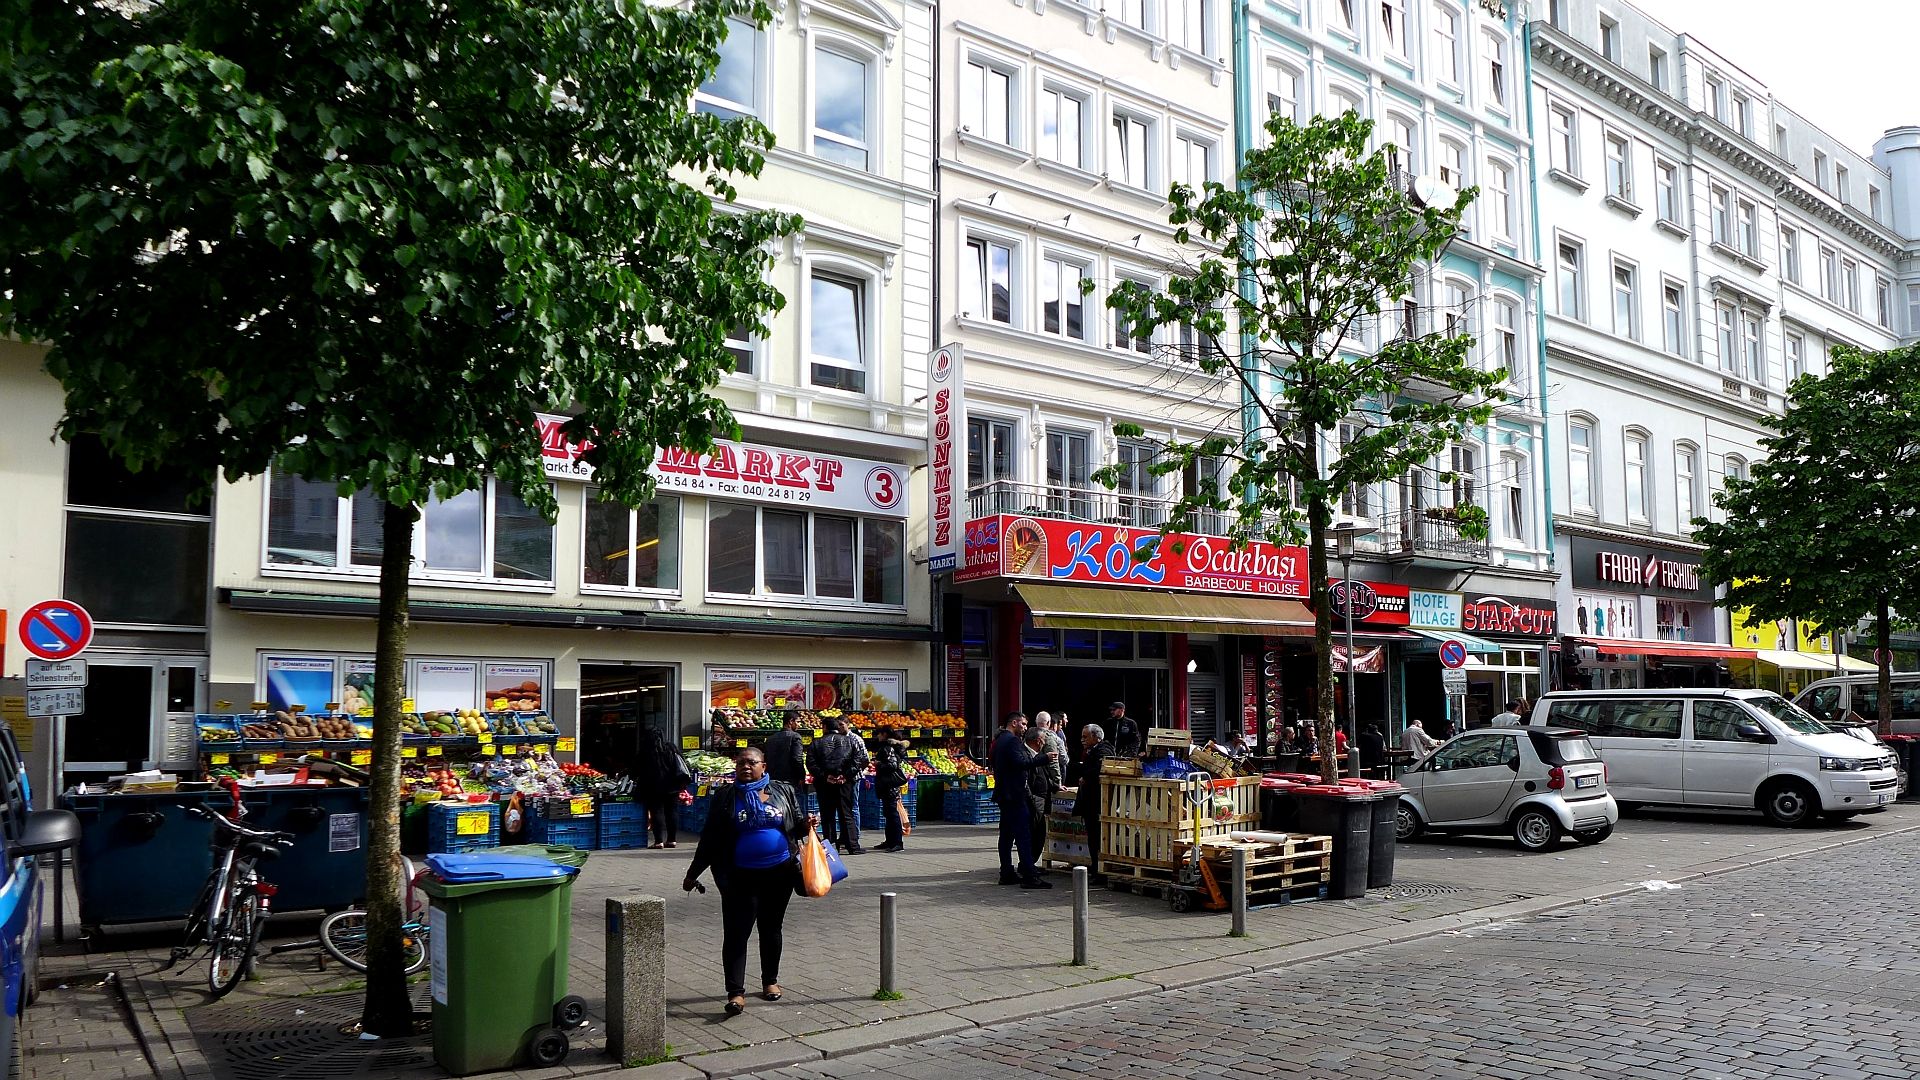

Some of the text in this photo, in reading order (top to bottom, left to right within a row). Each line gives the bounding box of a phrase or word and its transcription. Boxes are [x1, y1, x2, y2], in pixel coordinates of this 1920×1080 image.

[656, 442, 844, 492] MARKT
[933, 388, 951, 547] SÖNMEZ
[657, 474, 811, 502] 24 54 84 Fax: 040/ 24 81 29
[874, 472, 894, 504] 3
[929, 556, 955, 571] MARKT
[965, 549, 998, 567] cakbaşı
[1052, 528, 1165, 583] KÖZ
[1600, 551, 1642, 585] FABA
[1185, 575, 1300, 595] BARBECUE HOUSE
[1661, 560, 1700, 591] FASHION
[1413, 593, 1449, 609] HOTEL
[1464, 602, 1556, 635] STAR CUT
